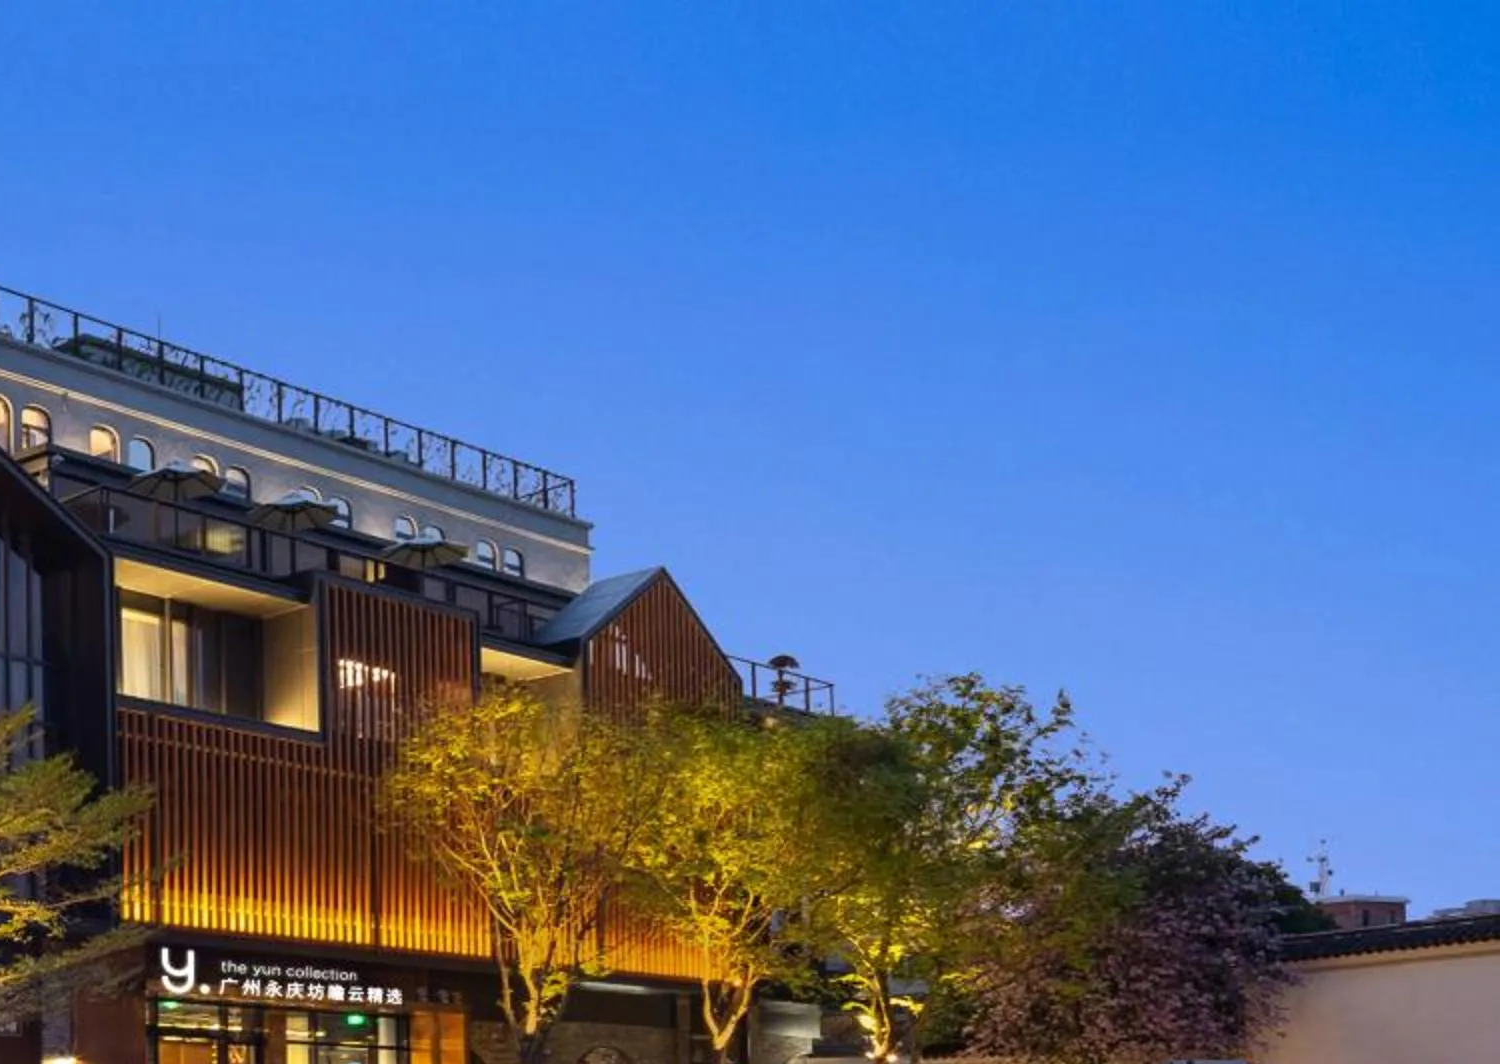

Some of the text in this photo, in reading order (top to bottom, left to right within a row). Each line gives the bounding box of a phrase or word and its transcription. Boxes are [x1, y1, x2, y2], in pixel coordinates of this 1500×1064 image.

[161, 947, 211, 995] y.
[220, 961, 359, 982] the yun collection
[218, 977, 403, 1005] 广州永庆坊瞻云精选
